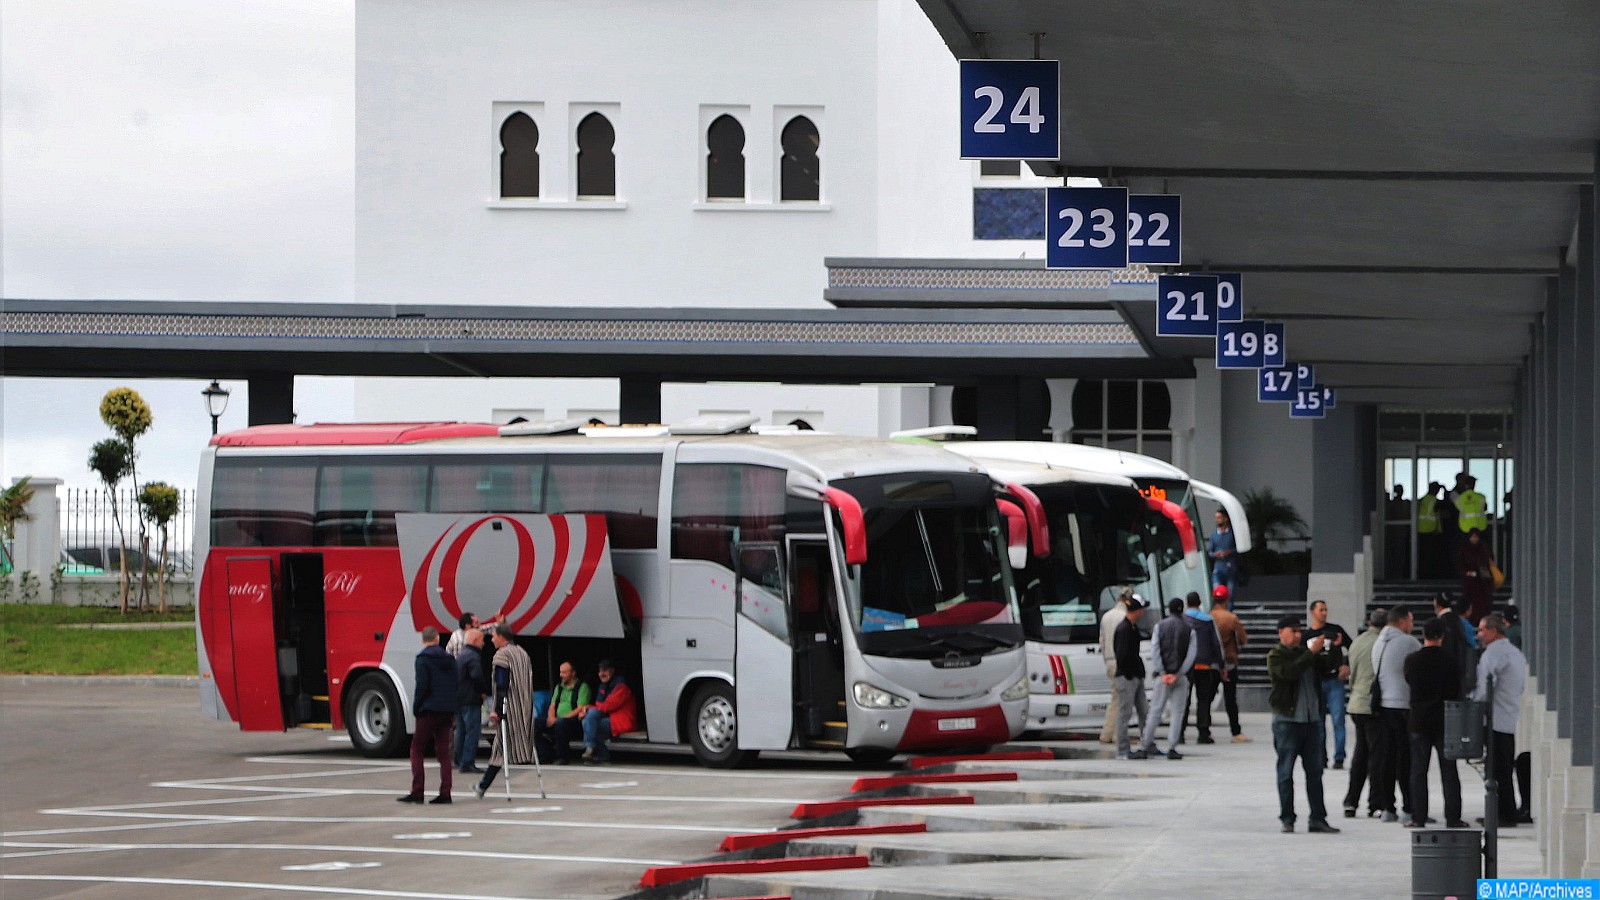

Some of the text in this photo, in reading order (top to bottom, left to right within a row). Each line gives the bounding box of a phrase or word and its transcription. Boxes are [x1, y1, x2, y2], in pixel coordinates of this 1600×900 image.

[974, 86, 1044, 133] 24
[1058, 208, 1115, 248] 23
[1129, 213, 1171, 246] 22
[1166, 291, 1209, 321] 21
[1217, 281, 1235, 309] 0
[1223, 332, 1258, 357] 19
[1265, 333, 1279, 356] 8
[1264, 371, 1293, 392] 17
[1295, 392, 1320, 410] 15
